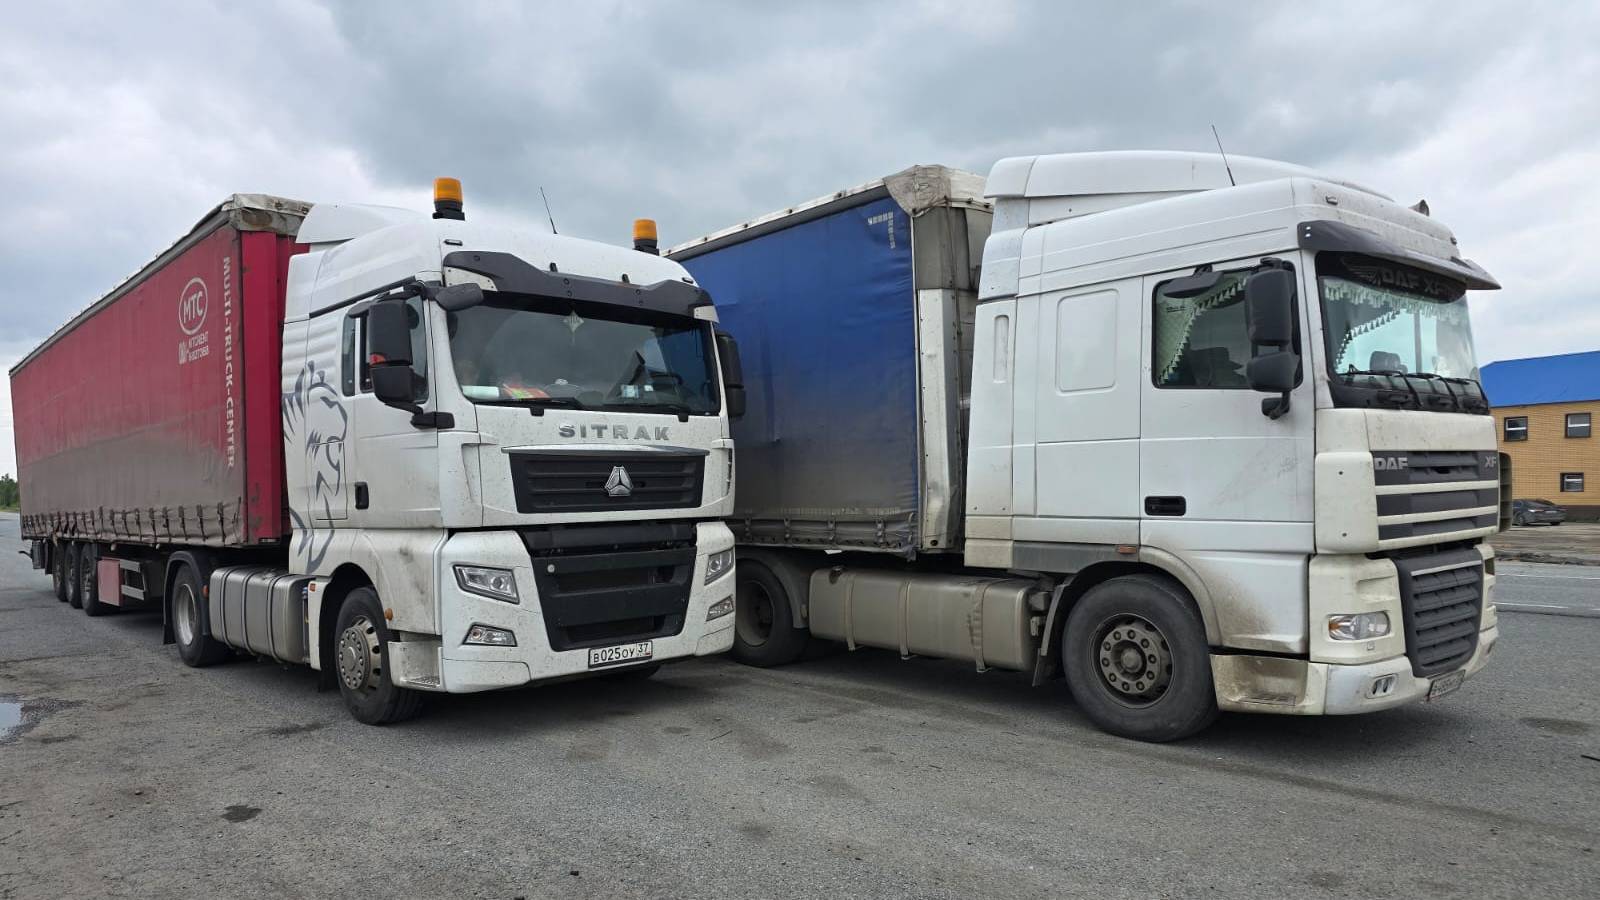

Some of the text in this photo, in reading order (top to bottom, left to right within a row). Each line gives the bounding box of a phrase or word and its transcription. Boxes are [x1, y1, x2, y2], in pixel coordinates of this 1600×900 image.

[184, 290, 203, 324] MTC
[224, 257, 235, 468] MULTI-TRUCK-CENTER
[558, 423, 670, 441] SITRAK
[1374, 457, 1408, 470] DAF
[1484, 456, 1497, 468] XF
[638, 642, 649, 653] 37
